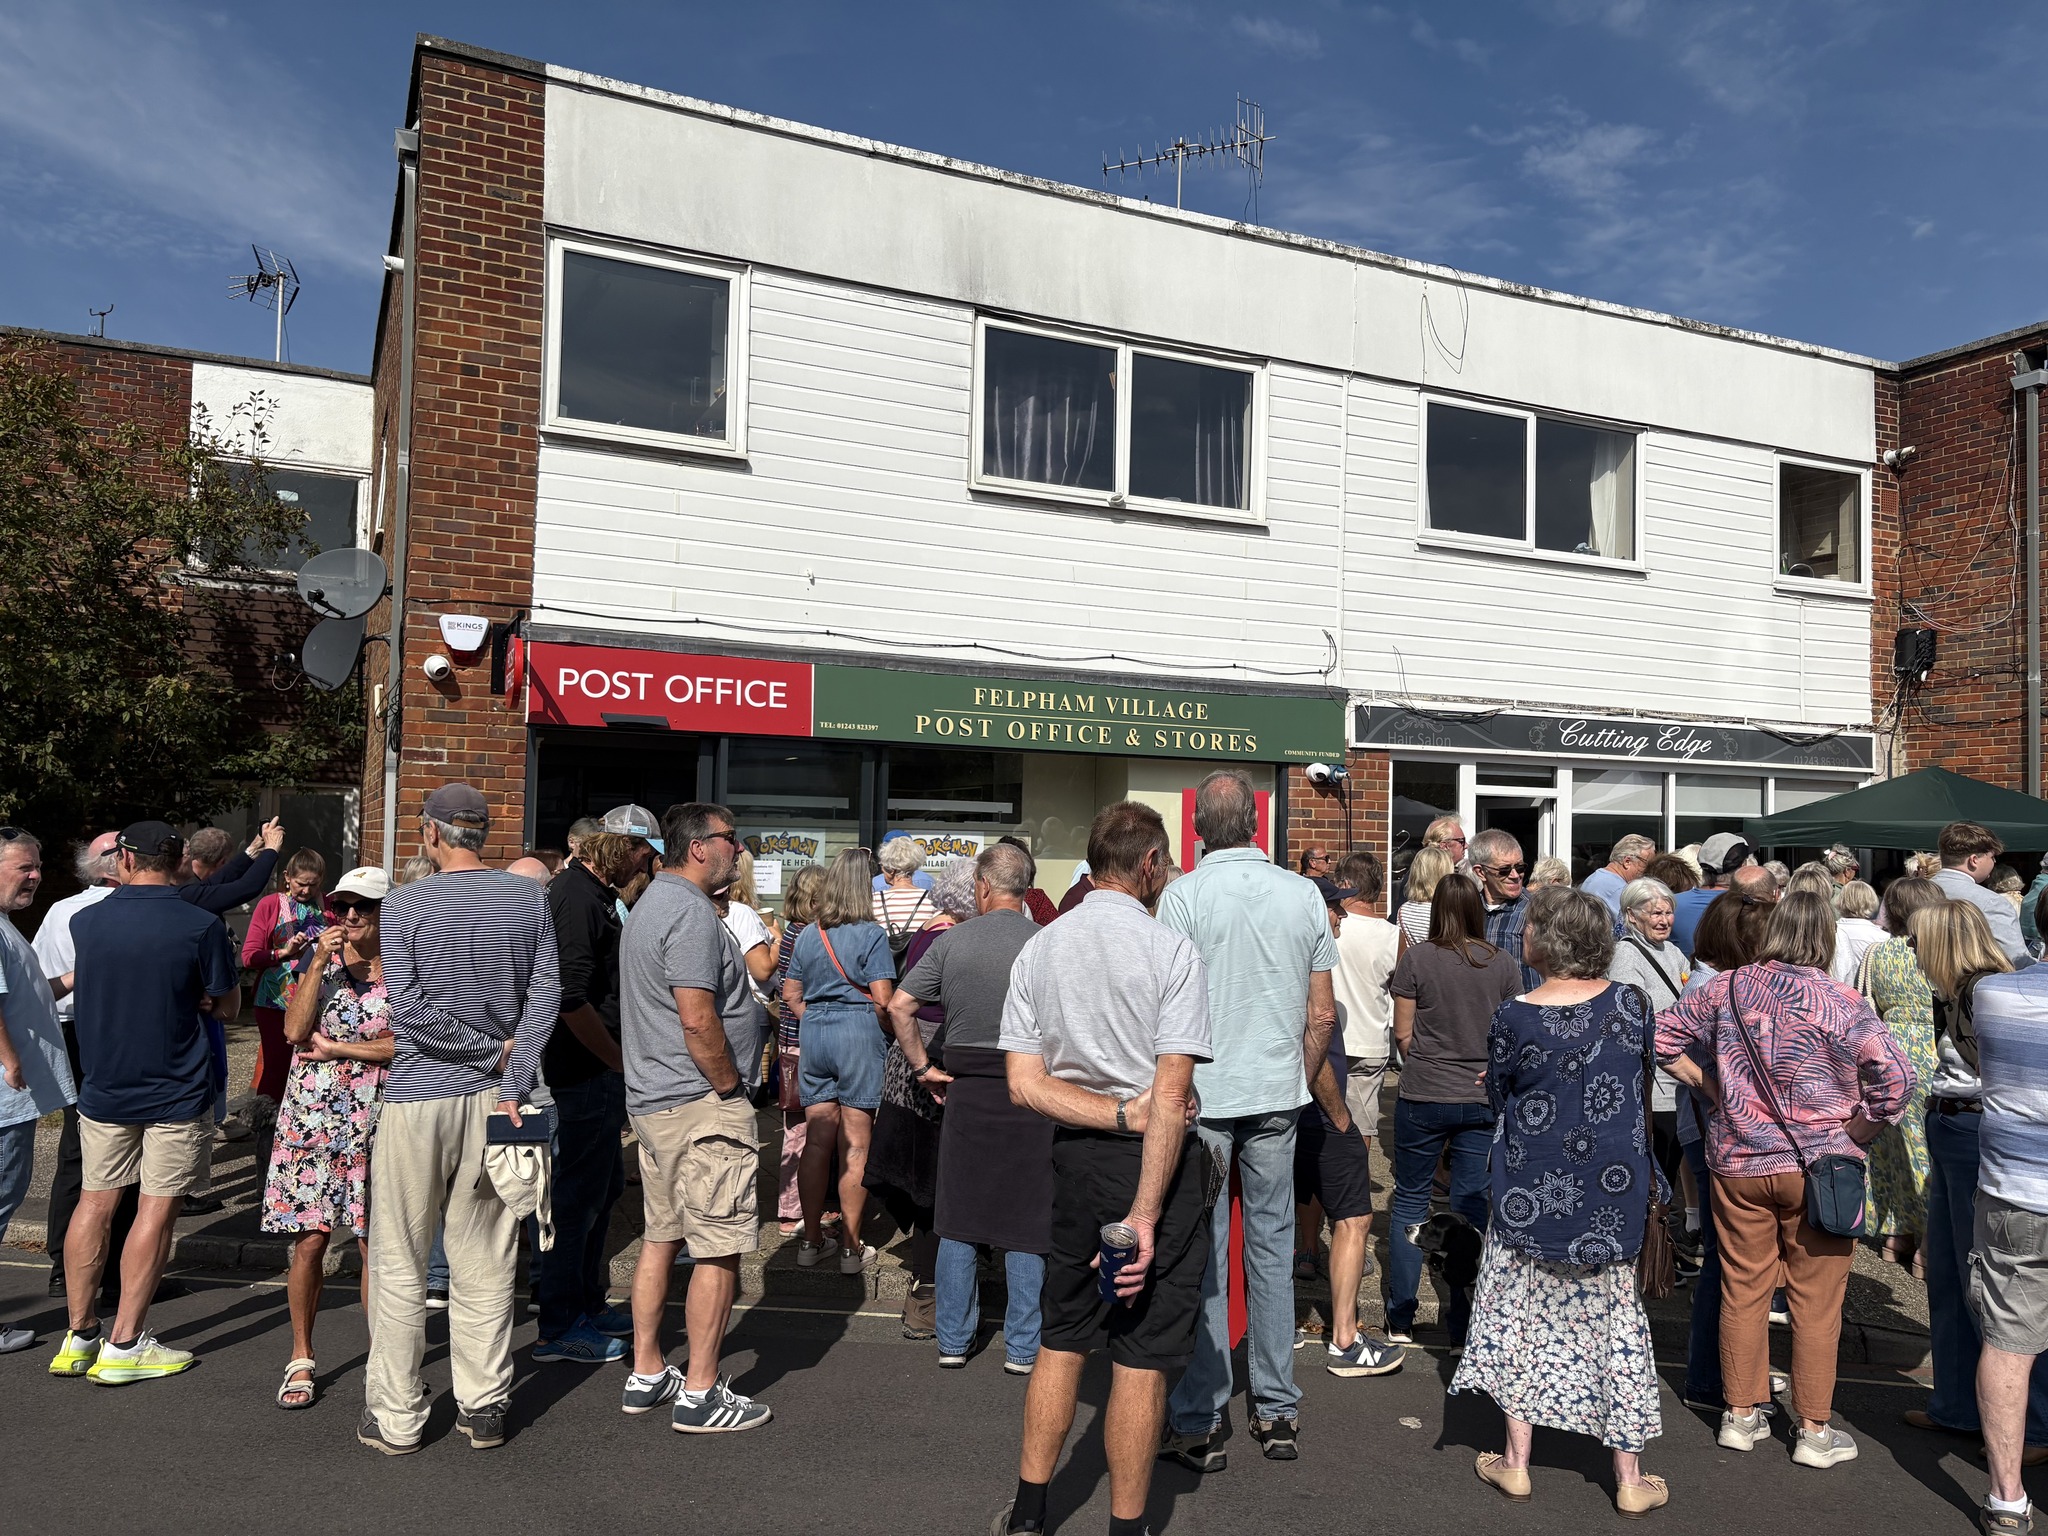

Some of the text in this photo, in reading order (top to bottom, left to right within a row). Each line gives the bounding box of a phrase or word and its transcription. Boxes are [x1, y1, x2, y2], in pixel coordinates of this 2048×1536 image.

[558, 667, 788, 709] POST OFFICE
[973, 687, 1209, 720] FELPHAM VILLAGE
[819, 721, 836, 729] TEL:
[836, 722, 856, 730] 01243
[914, 715, 1258, 753] POST OFFICE & STORES
[1387, 731, 1452, 747] Hair Salon
[1558, 718, 1713, 760] Cutting Edge
[1284, 749, 1318, 757] COMMUNITY
[1793, 755, 1819, 765] 01243
